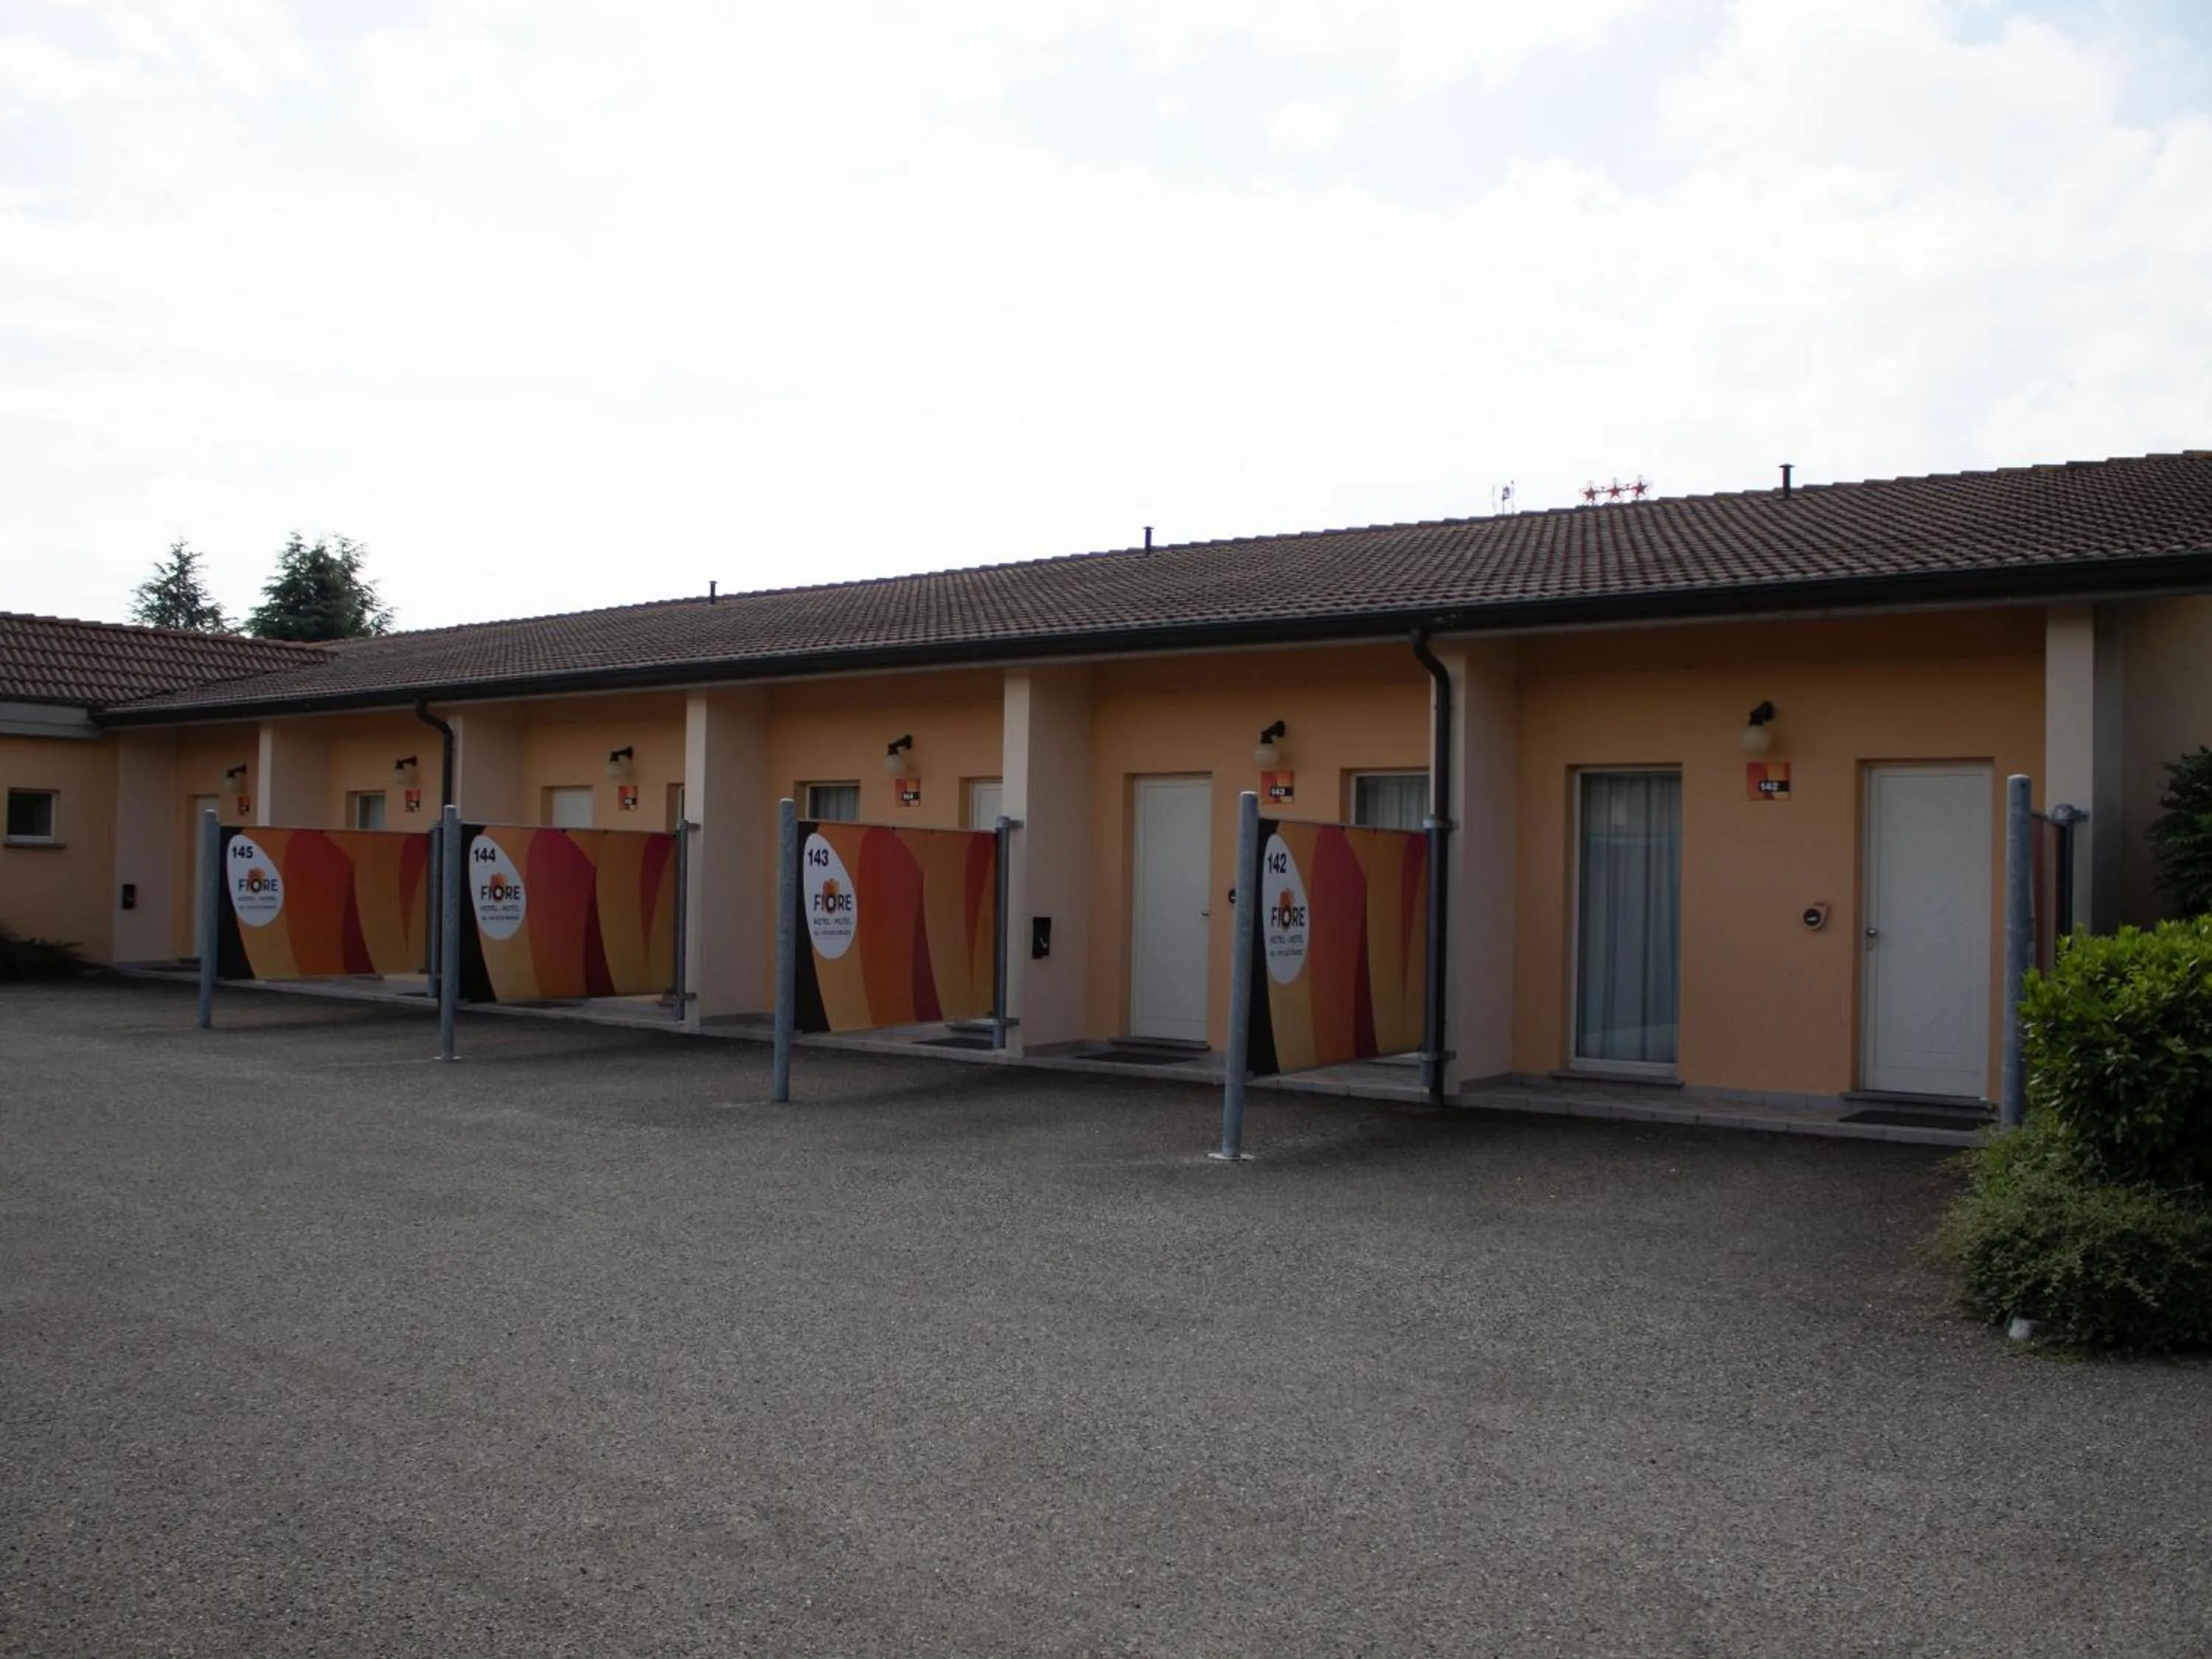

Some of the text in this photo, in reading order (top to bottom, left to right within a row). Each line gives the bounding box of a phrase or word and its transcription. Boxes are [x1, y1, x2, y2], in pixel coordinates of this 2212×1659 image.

[232, 846, 254, 859] 145
[474, 848, 496, 862] 144
[808, 849, 829, 866] 143
[1267, 852, 1287, 873] 142
[237, 878, 279, 893] FIORE
[481, 886, 520, 901] FIORE
[813, 894, 852, 913] FIORE
[1270, 906, 1305, 928] FIORE
